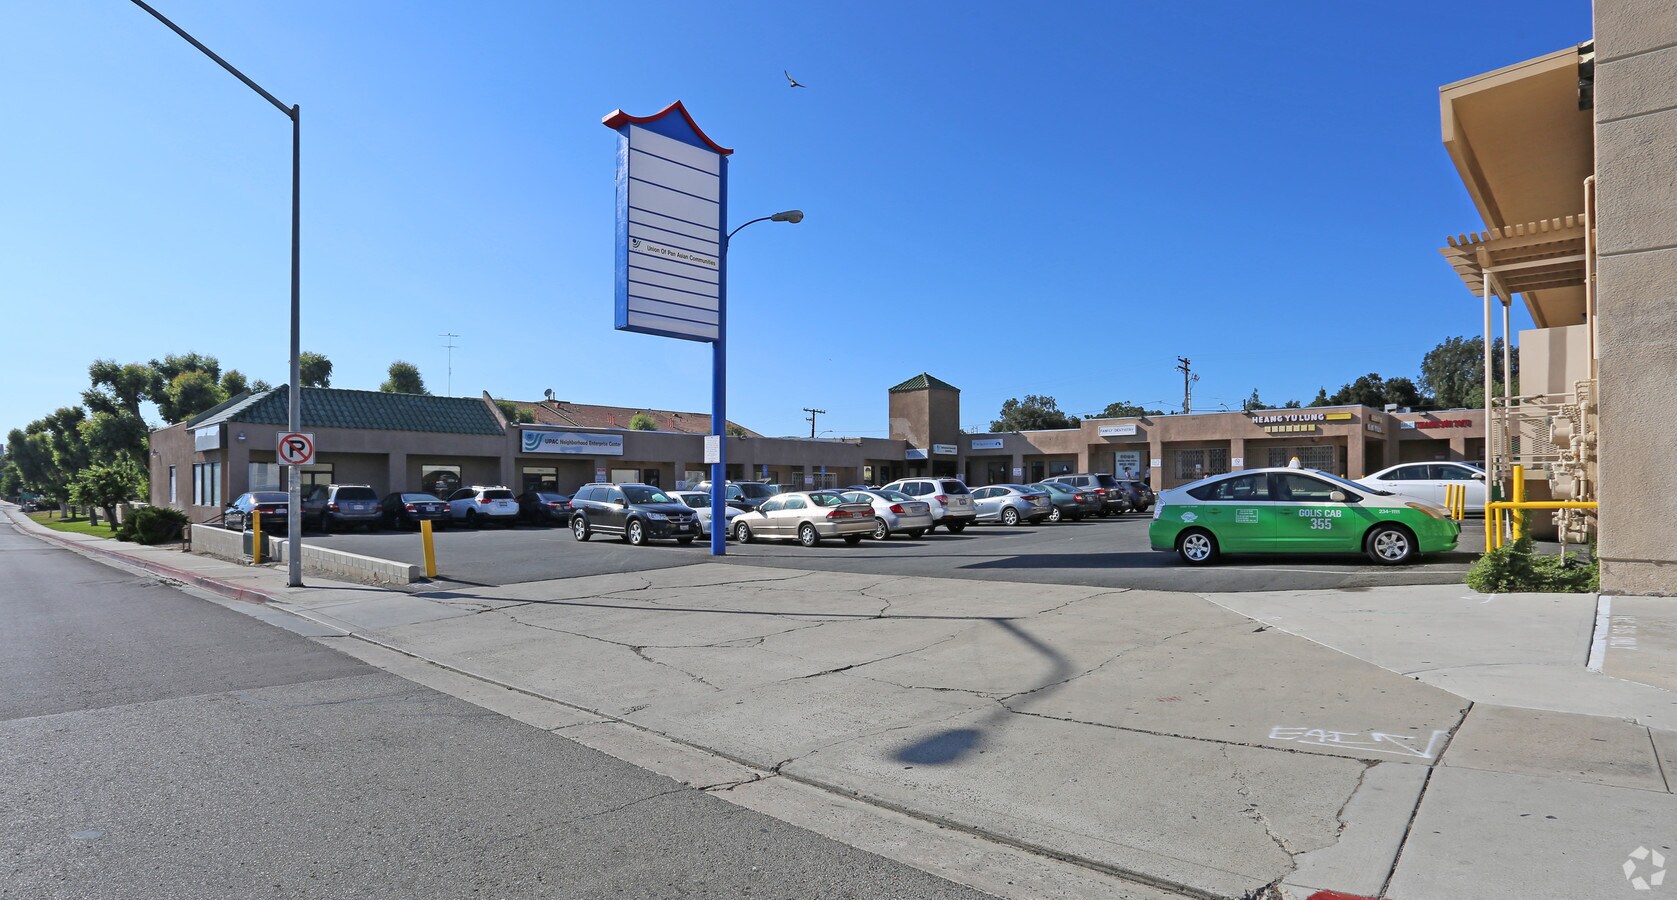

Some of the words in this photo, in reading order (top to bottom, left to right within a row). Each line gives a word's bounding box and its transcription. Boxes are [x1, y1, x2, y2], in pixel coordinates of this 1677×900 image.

[647, 245, 660, 253] Union
[689, 255, 715, 266] Communities
[1252, 415, 1283, 424] HEANG
[1298, 509, 1322, 517] GOLIS
[1324, 509, 1342, 517] CAB
[1310, 518, 1332, 530] 355
